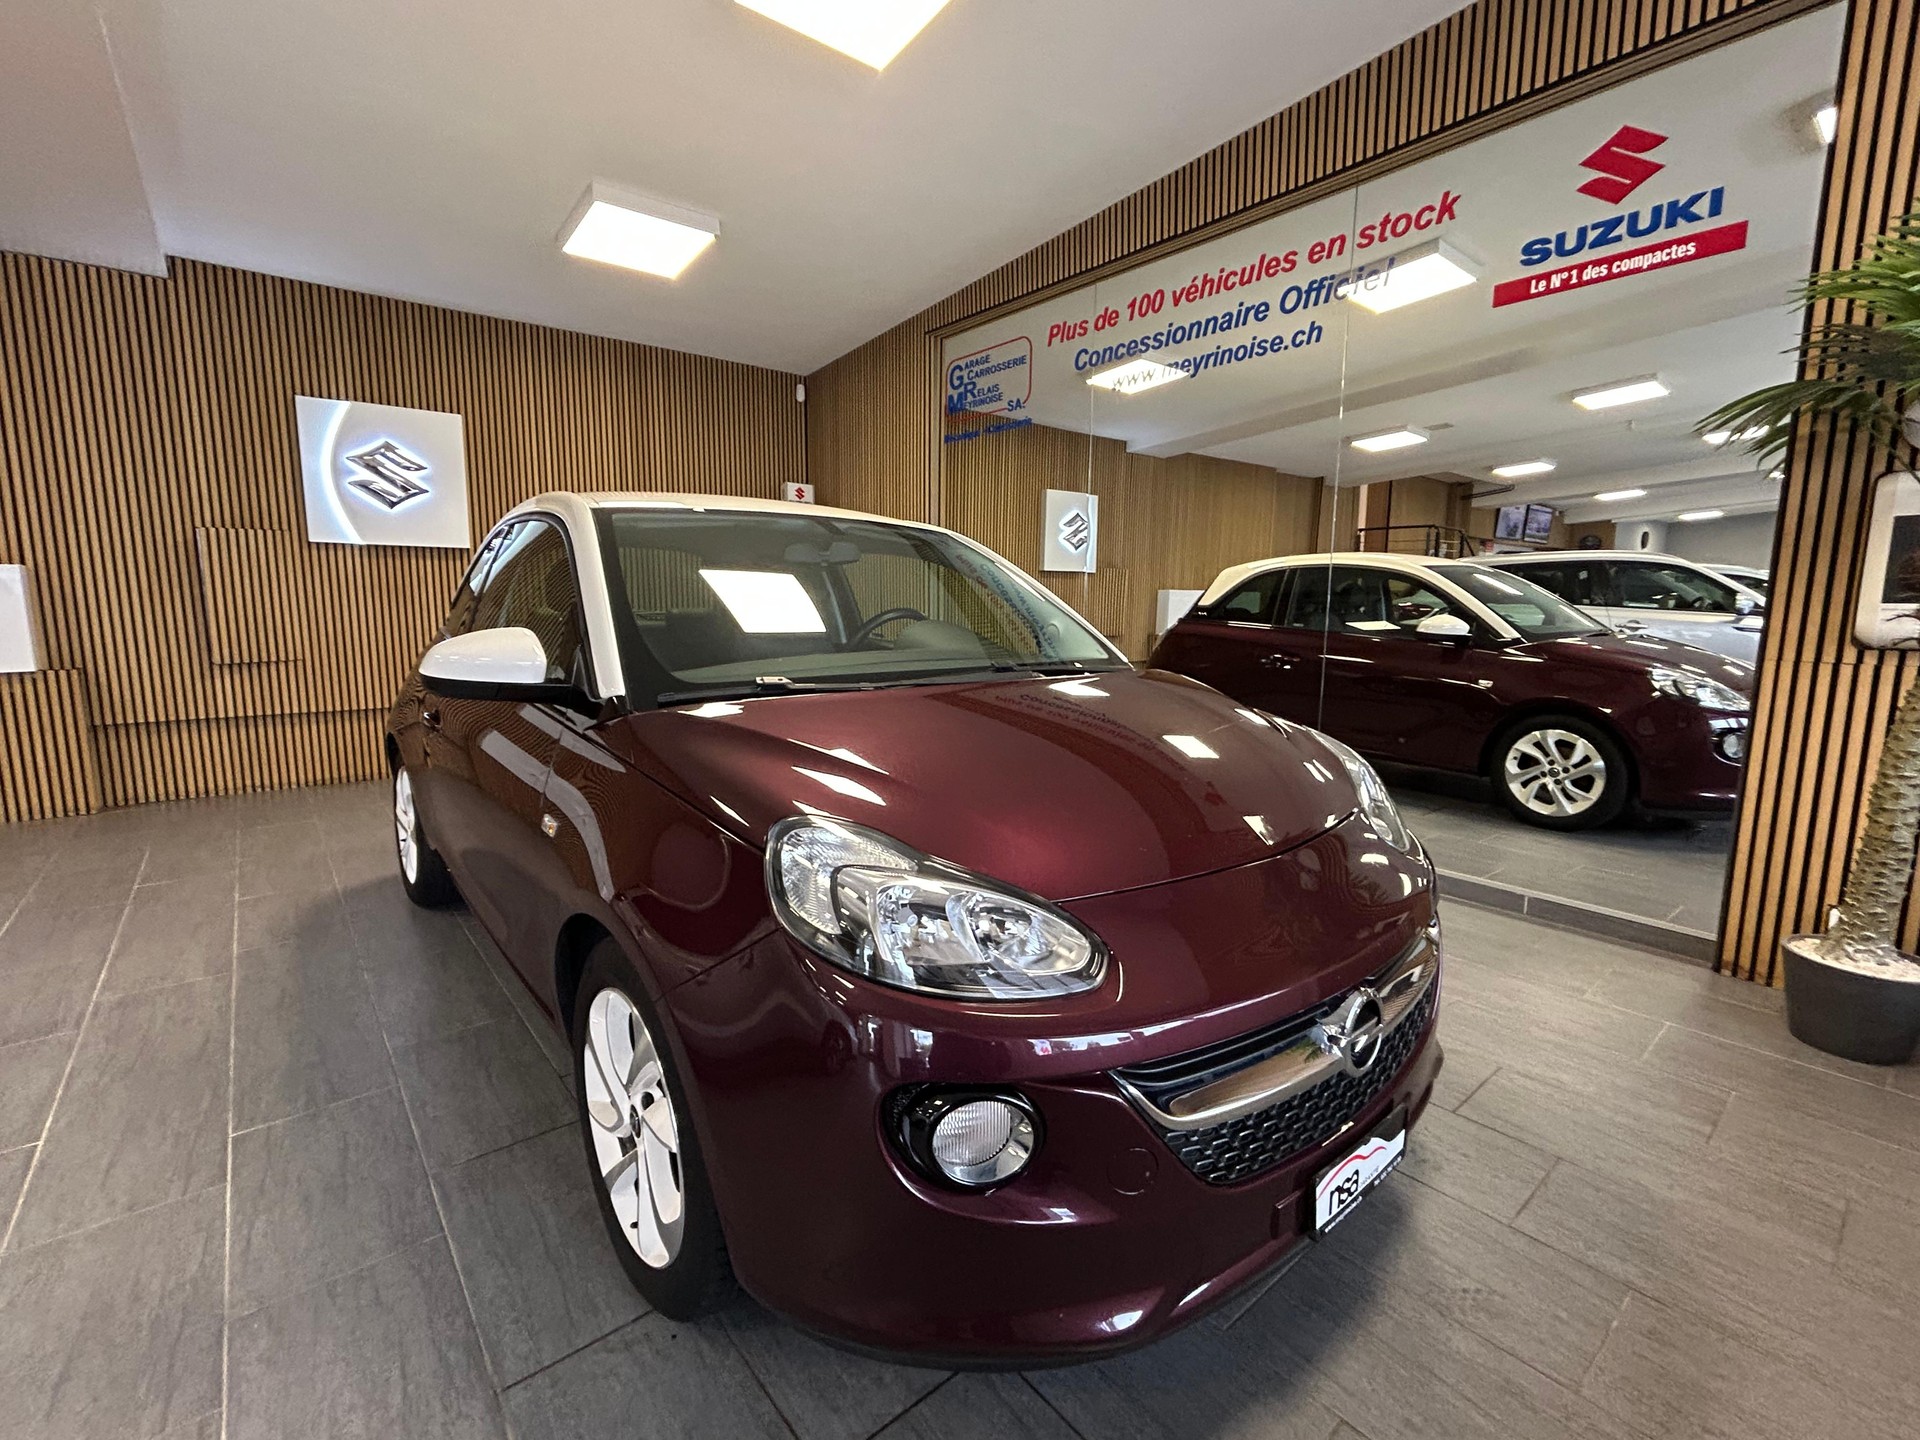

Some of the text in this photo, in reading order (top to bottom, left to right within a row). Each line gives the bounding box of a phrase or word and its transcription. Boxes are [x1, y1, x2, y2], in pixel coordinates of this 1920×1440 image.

[1519, 186, 1725, 267] SUZUKI
[1047, 190, 1462, 348] Plus de 100 véhicules en stock
[1529, 278, 1547, 294] Le
[1582, 263, 1608, 281] des
[1611, 241, 1697, 272] compactes
[1074, 256, 1396, 371] Concessionnaire Officiel
[949, 354, 991, 390] GARAGE
[963, 381, 1000, 401] RELAIS
[966, 354, 1028, 381] CARROSSERIE
